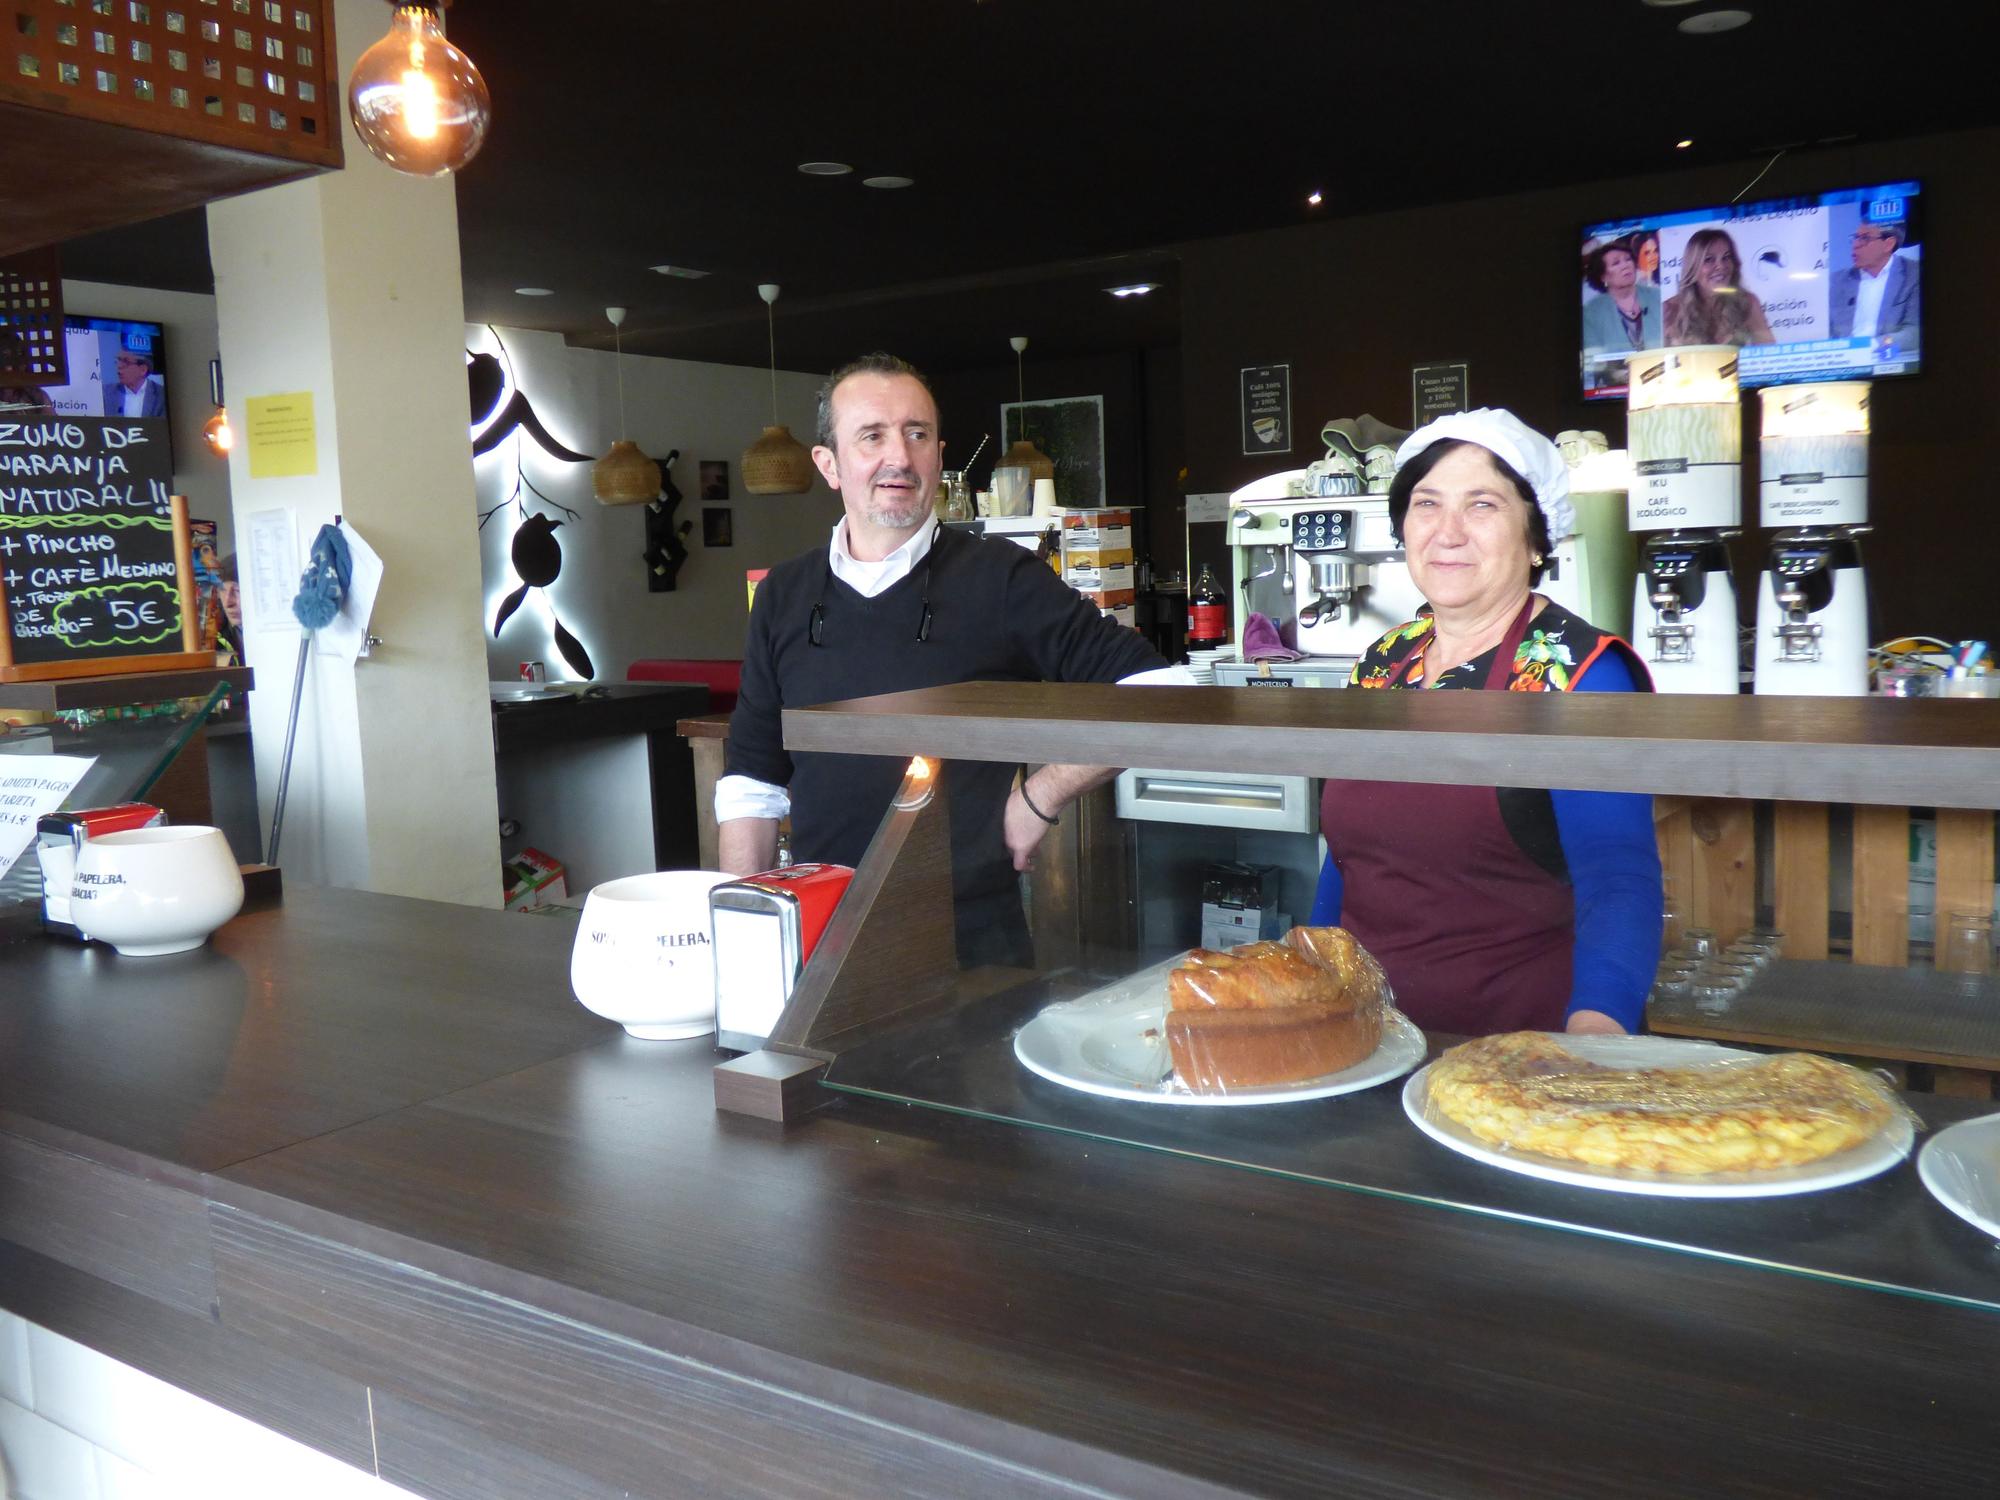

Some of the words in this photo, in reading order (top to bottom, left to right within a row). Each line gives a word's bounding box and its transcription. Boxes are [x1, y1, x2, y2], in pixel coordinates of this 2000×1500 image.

[0, 423, 85, 449] ZUMO
[102, 427, 149, 449] DE
[1649, 479, 1668, 488] IKU
[15, 609, 45, 623] DE
[109, 601, 165, 631] 5€
